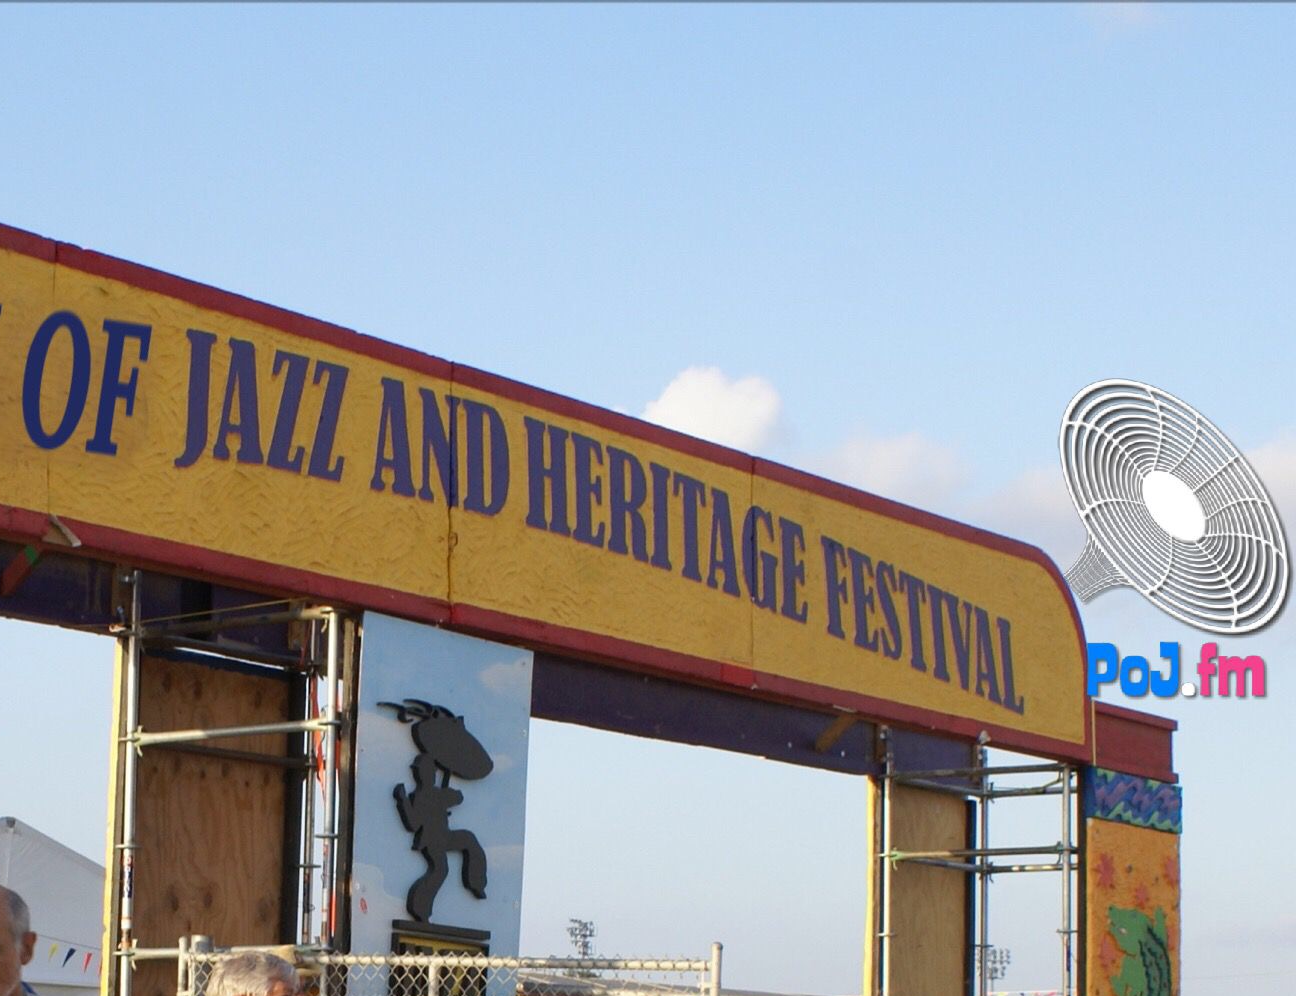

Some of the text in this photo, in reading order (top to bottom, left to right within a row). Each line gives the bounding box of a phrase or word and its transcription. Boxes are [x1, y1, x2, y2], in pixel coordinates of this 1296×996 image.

[22, 311, 152, 456] OF
[174, 328, 349, 482] JAZZ
[370, 376, 510, 517] AND
[524, 416, 809, 622] HERITAGE
[821, 536, 1025, 716] FESTIVAL
